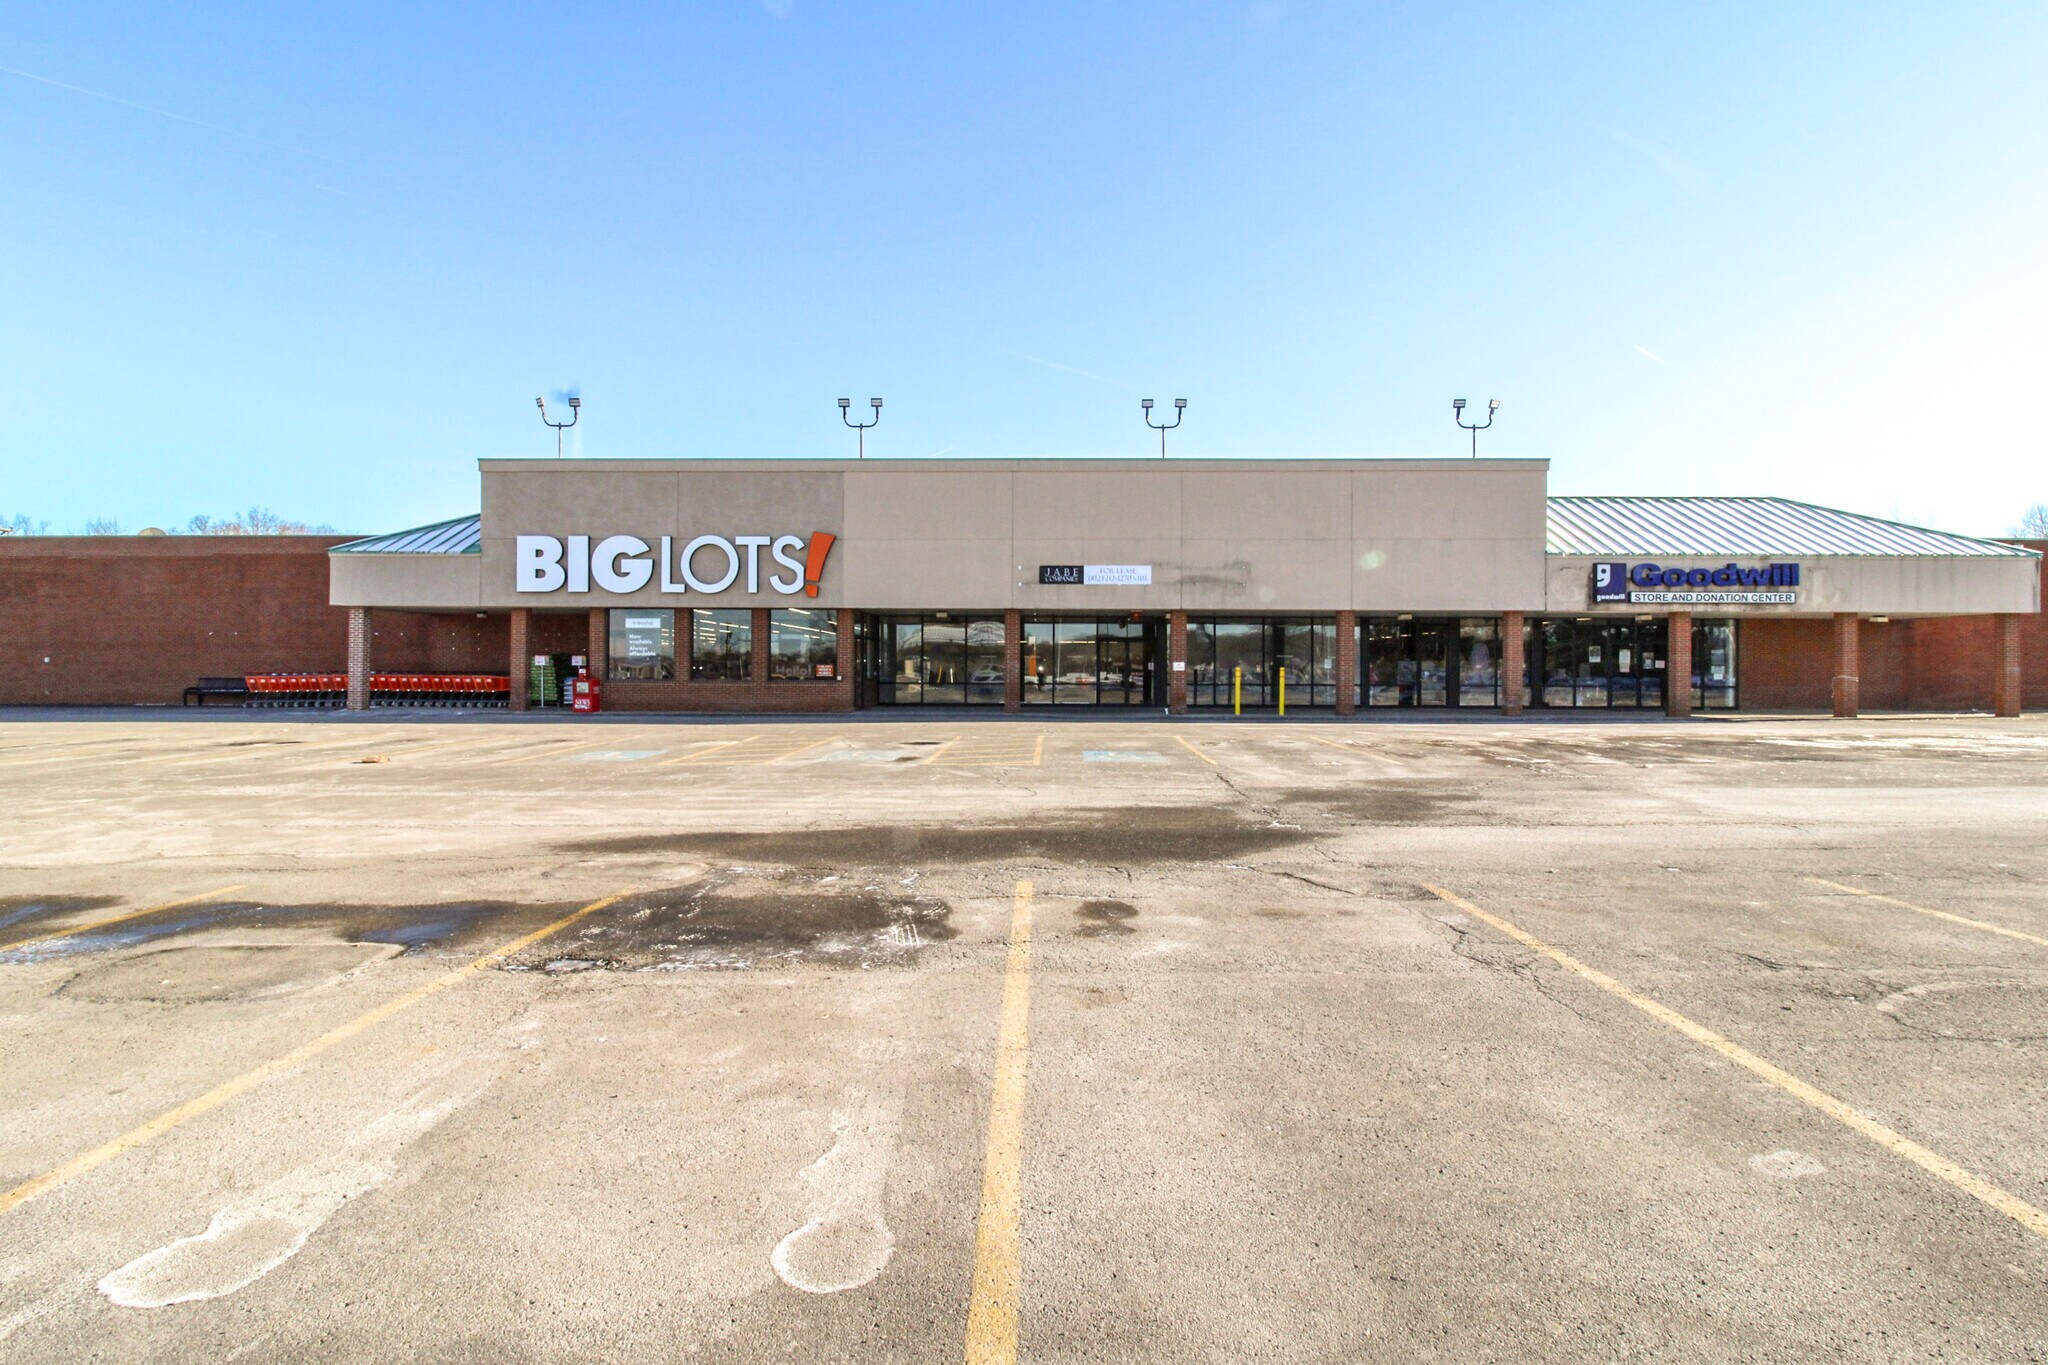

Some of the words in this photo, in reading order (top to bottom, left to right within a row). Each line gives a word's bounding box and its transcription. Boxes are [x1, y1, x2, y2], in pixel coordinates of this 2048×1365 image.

[516, 535, 653, 594] BIG
[660, 531, 836, 598] LOTS!
[1632, 563, 1799, 587] Goodwill
[1597, 594, 1625, 602] goodwill
[1634, 593, 1670, 602] STORE
[1672, 593, 1693, 602] AND
[1696, 593, 1749, 602] DONATION
[1752, 593, 1792, 602] CENTER
